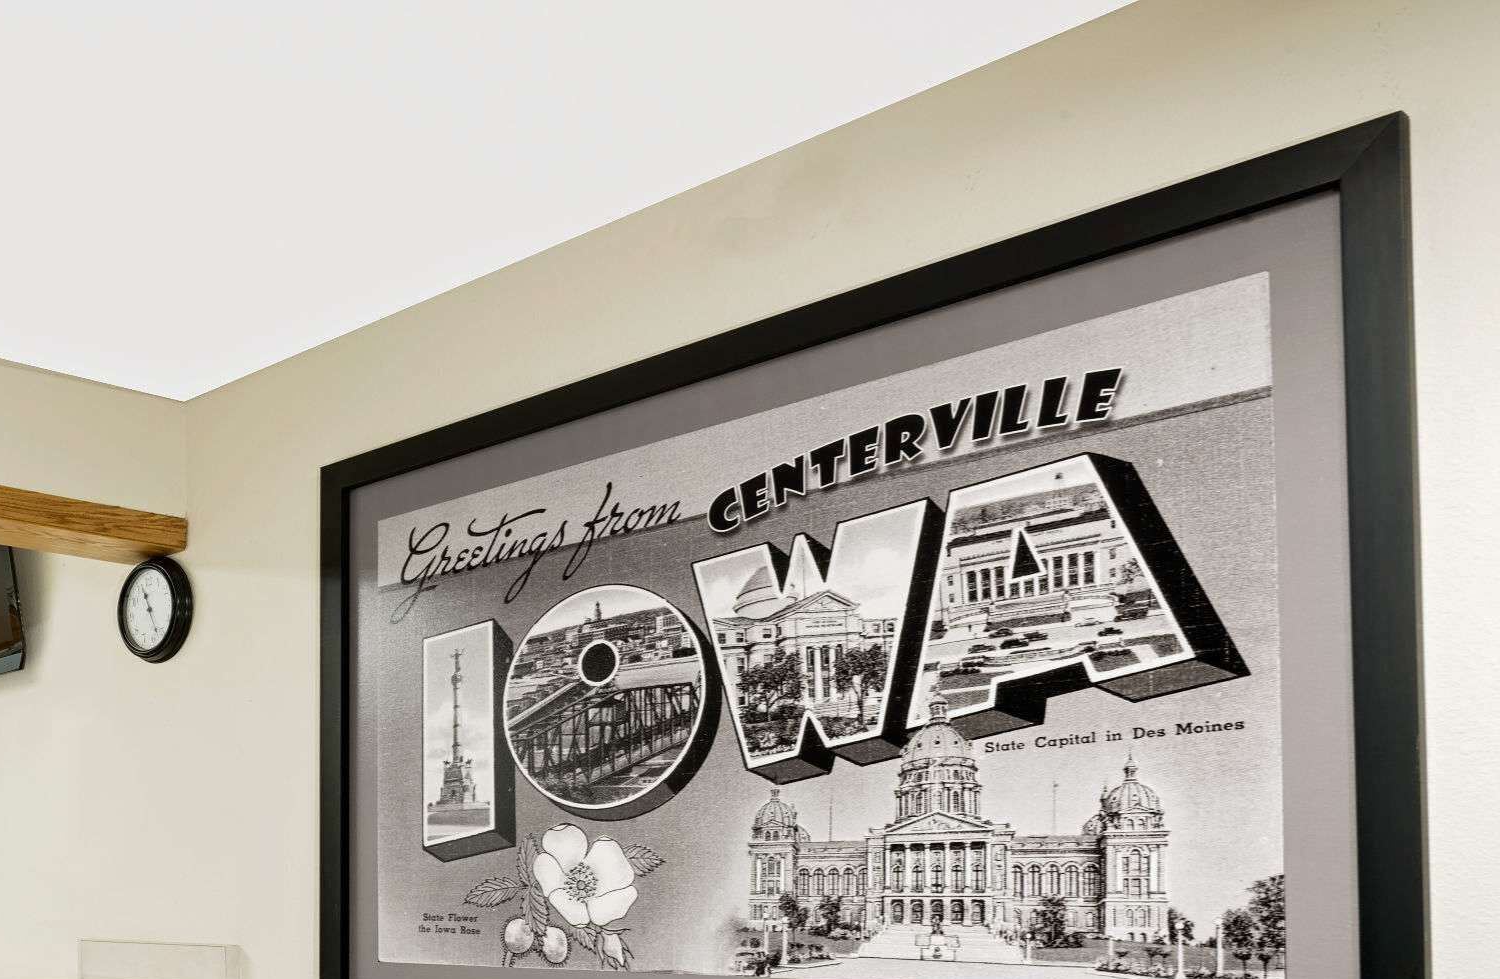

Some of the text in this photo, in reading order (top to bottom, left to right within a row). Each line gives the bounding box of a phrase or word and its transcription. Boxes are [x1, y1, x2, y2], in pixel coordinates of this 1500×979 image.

[706, 367, 1124, 534] CENTERVILLE
[389, 481, 682, 624] Greetings from
[421, 451, 1251, 864] IOWA
[984, 719, 1246, 753] State Capital in Des Moines
[418, 924, 482, 935] the Iowa Rose
[422, 912, 479, 923] State Flower
